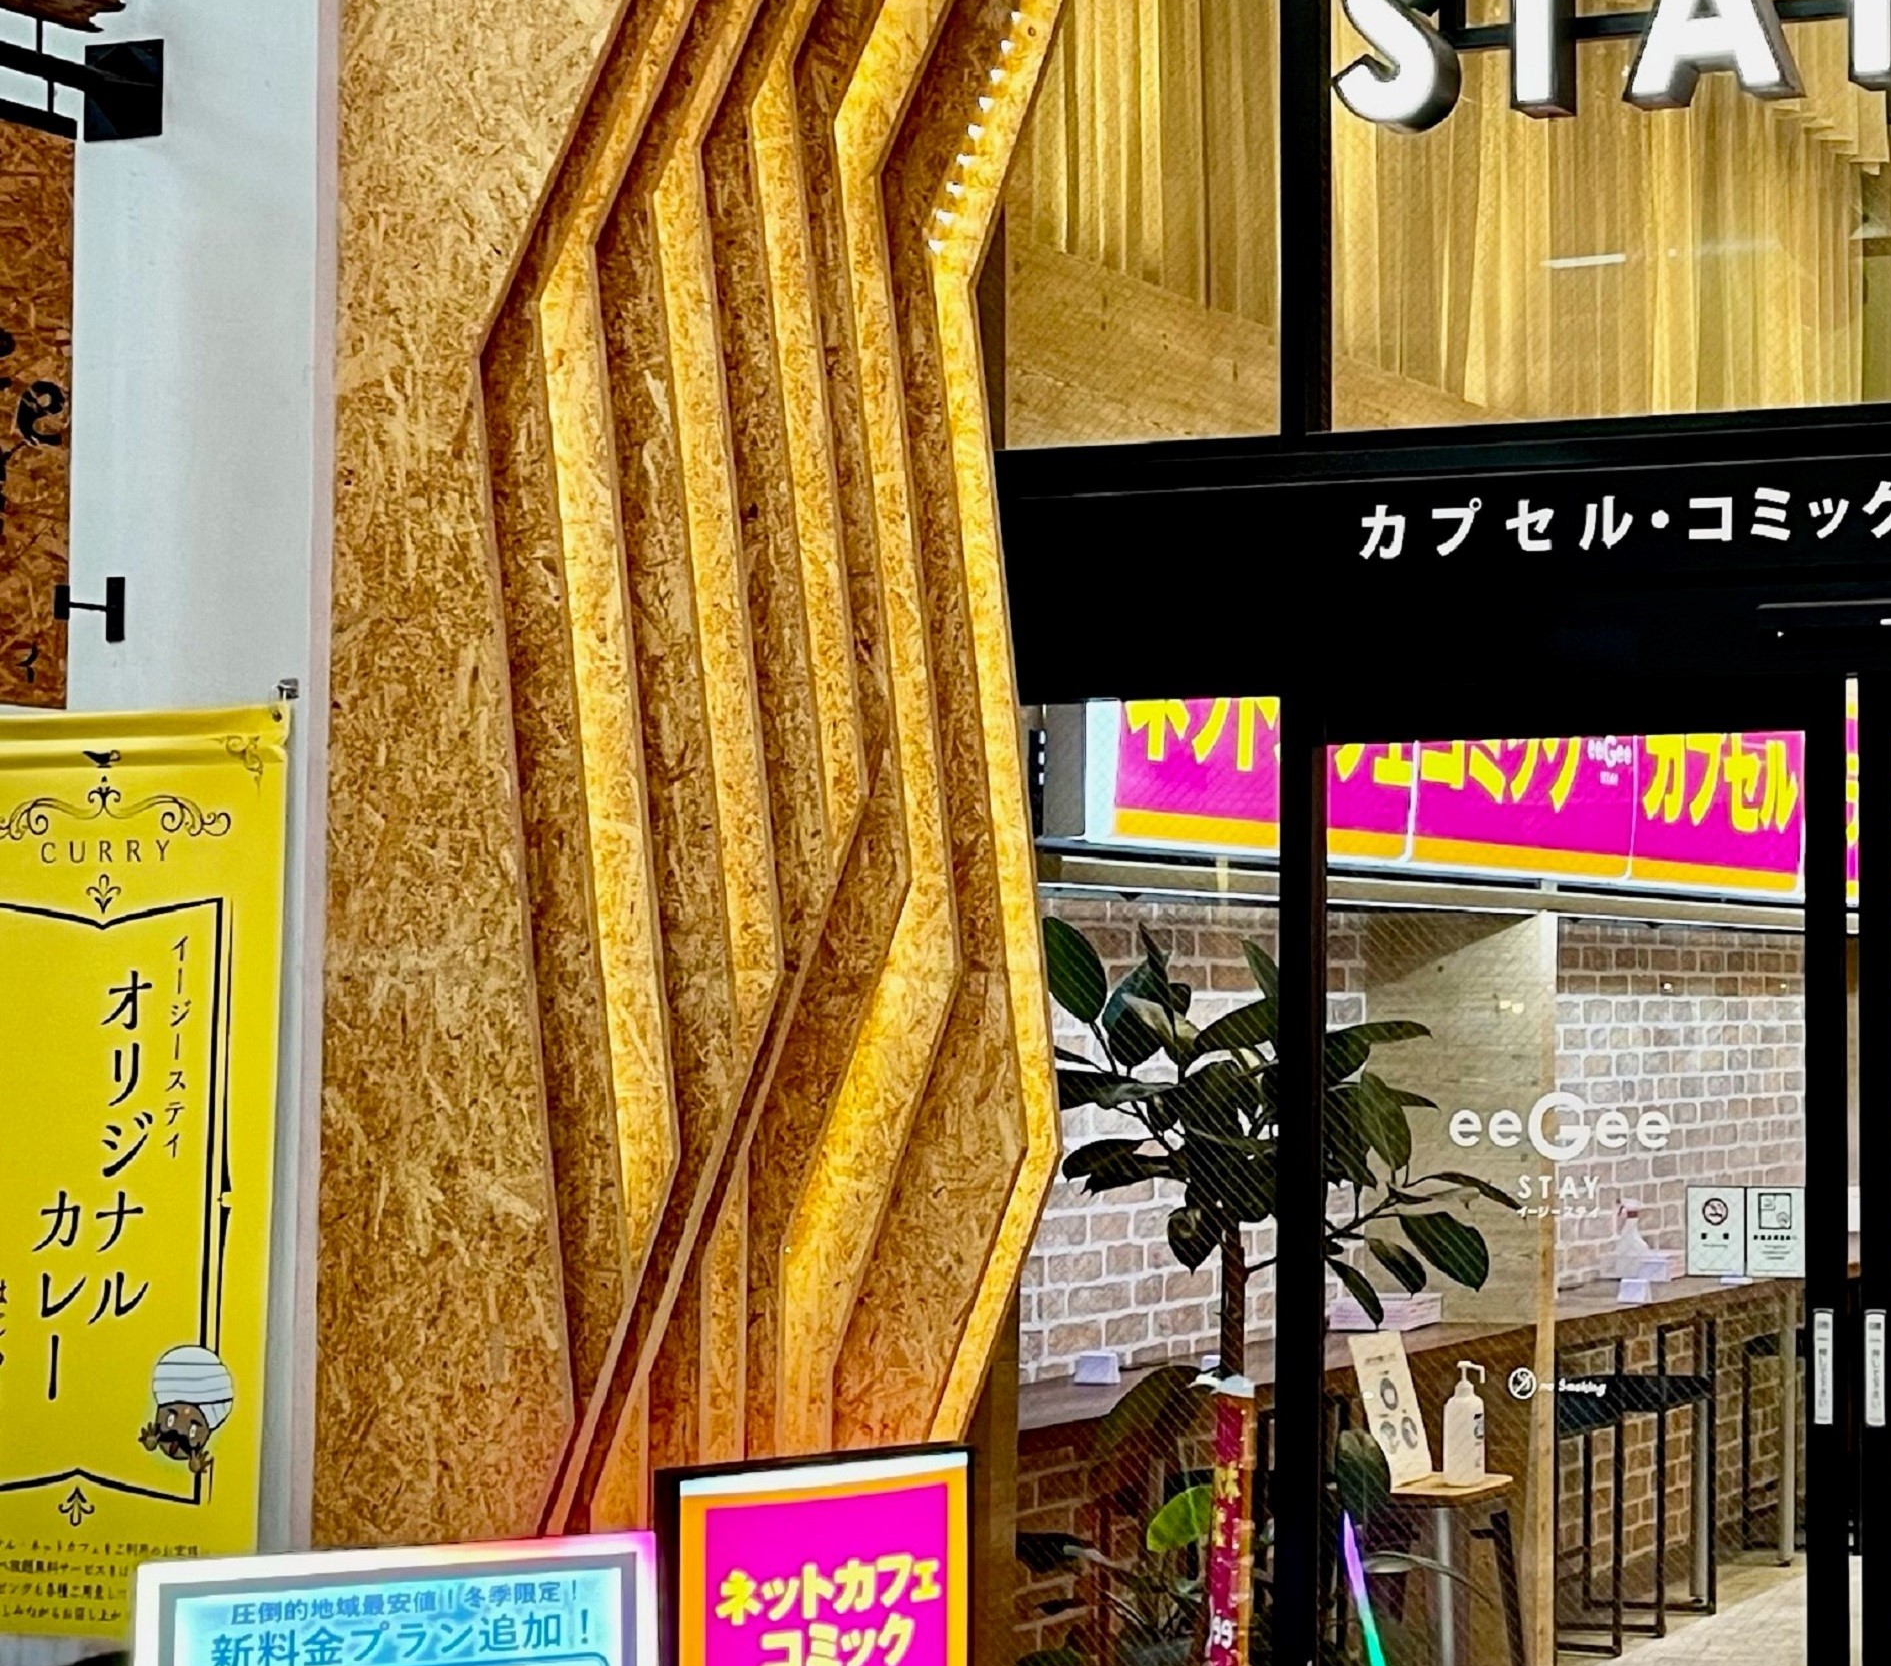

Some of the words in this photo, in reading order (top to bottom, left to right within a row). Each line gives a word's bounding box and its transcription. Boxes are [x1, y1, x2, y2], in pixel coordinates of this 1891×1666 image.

[41, 839, 172, 865] CURRY
[163, 935, 191, 1159] イージーステイ
[89, 971, 154, 1327] オリジナル
[1450, 1092, 1671, 1160] eeGee
[1517, 1175, 1599, 1199] STAY
[33, 1190, 88, 1400] カレー
[717, 1554, 941, 1626] ネットカフェ
